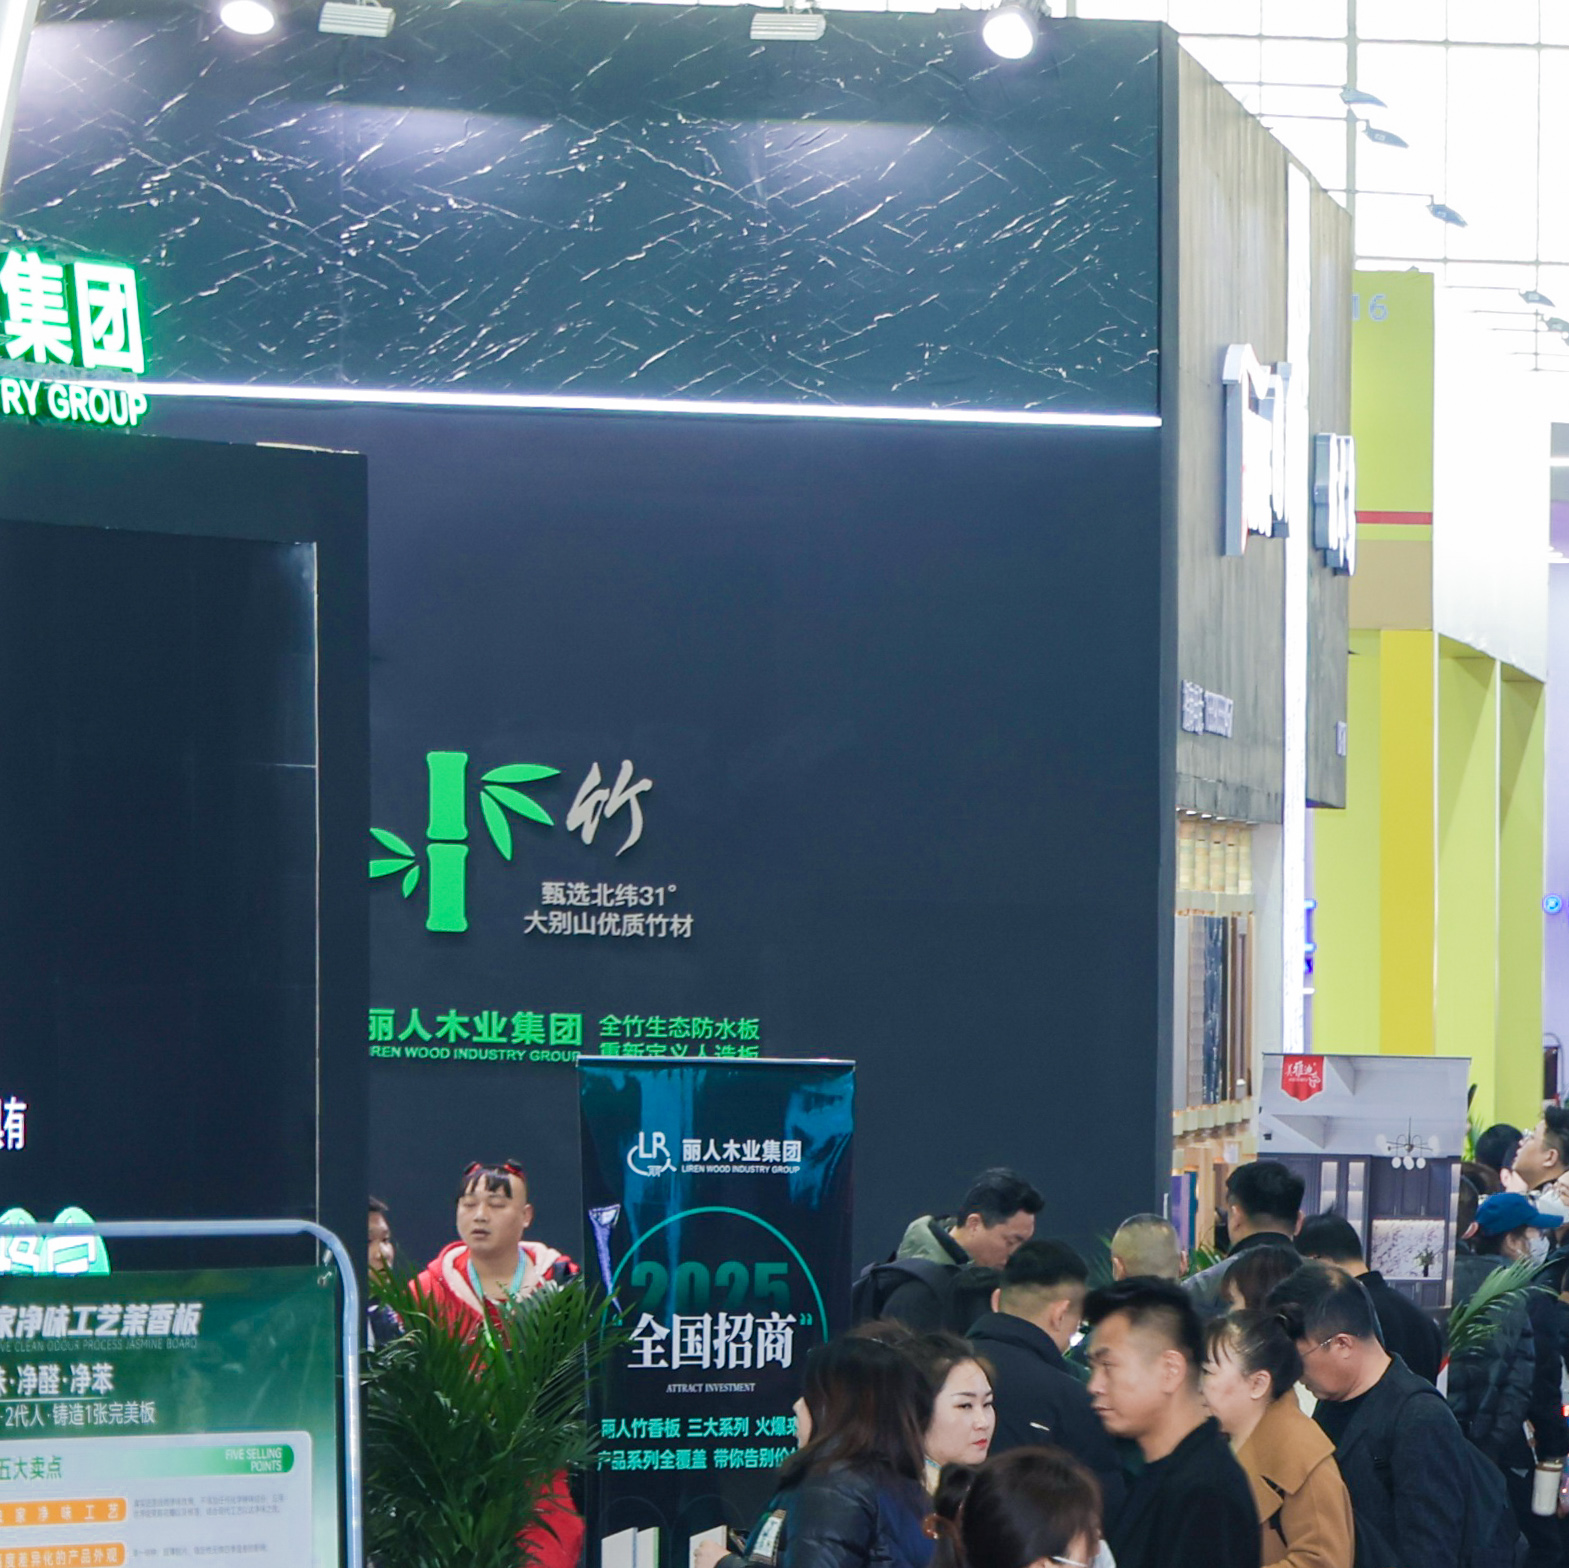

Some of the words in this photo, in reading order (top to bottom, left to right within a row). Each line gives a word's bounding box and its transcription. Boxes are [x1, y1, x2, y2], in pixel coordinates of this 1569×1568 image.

[0, 250, 146, 375] 集团
[47, 382, 148, 427] GROUP
[566, 759, 653, 857] 竹
[541, 881, 678, 908] 甄选北纬31°
[523, 911, 694, 939] 大别山优质竹材
[369, 1008, 583, 1046] 丽人木业集团
[599, 1014, 760, 1041] 全竹生态防水板
[404, 1045, 450, 1060] WOOD
[453, 1047, 526, 1061] INDUSTRY
[529, 1050, 582, 1063] GROUP
[682, 1139, 802, 1163] 丽人木业集团
[681, 1165, 705, 1174] LIREN
[707, 1165, 731, 1174] WOOD
[732, 1165, 770, 1174] INDUSTRY
[772, 1165, 801, 1175] GROUP
[631, 1261, 790, 1311] 2025
[14, 1341, 43, 1352] CLEAN
[83, 1339, 122, 1350] PROCESS
[126, 1338, 162, 1349] JASMINE
[166, 1338, 197, 1348] BOARD
[666, 1383, 704, 1393] ATTRACT
[705, 1382, 756, 1393] INVESTMENT
[687, 1417, 749, 1438] 三大系列
[225, 1449, 244, 1460] FIVE
[246, 1447, 282, 1460] SELLING
[250, 1460, 282, 1471] POINTS
[597, 1450, 706, 1471] 产品系列全覆盖
[0, 1455, 62, 1480] 五大卖点
